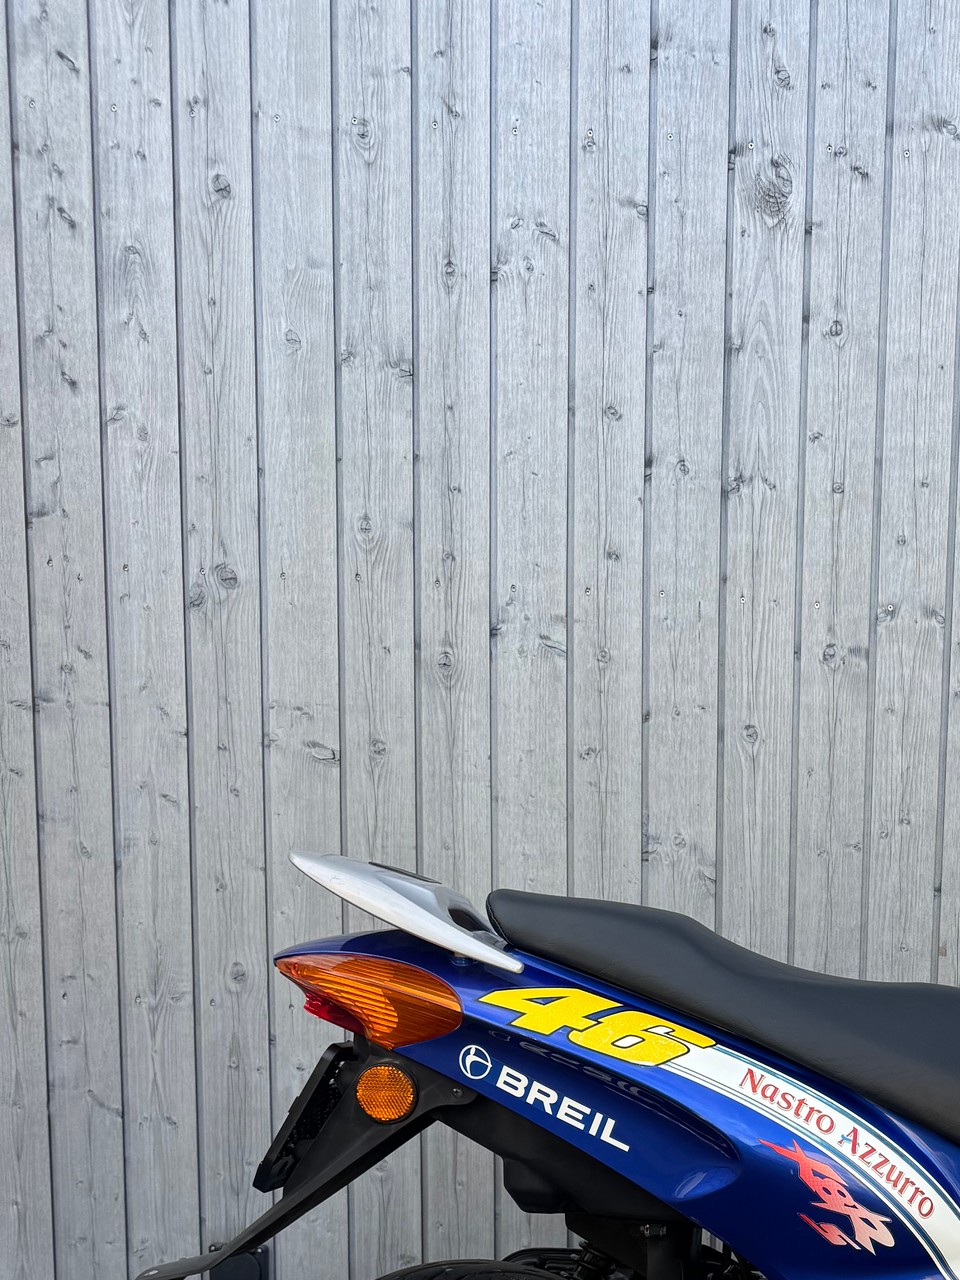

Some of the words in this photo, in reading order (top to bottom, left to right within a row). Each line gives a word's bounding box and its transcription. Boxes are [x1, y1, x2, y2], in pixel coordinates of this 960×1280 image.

[478, 987, 717, 1067] 46
[496, 1065, 630, 1152] BREIL
[739, 1068, 836, 1134] Nastro
[839, 1126, 935, 1219] Azzurro
